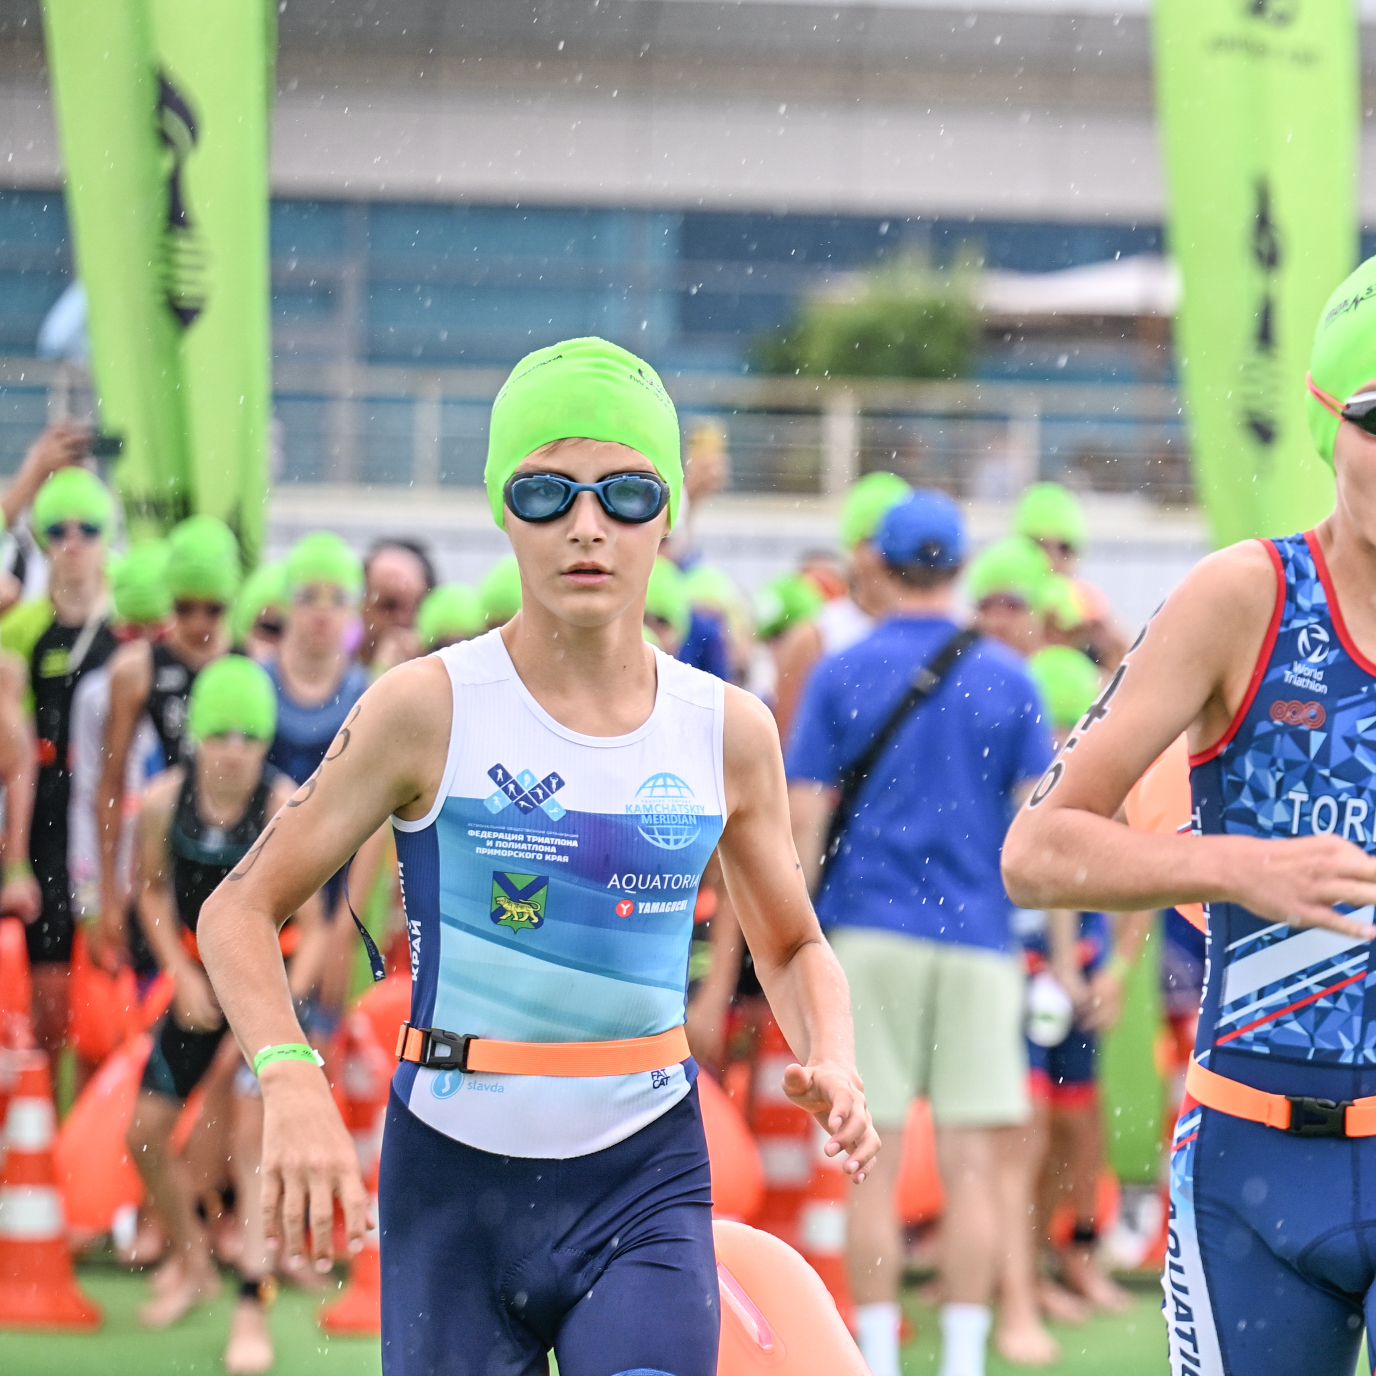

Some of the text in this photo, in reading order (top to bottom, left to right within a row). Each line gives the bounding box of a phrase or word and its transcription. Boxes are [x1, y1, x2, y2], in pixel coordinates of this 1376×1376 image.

[1293, 661, 1324, 681] World
[1283, 670, 1328, 695] Triathlon
[625, 804, 705, 814] KAMCHATSKIY
[641, 814, 697, 825] MERIDIAN
[468, 829, 578, 847] ФЕДЕРАЦИЯ ТРИАТЛОНА
[495, 840, 557, 853] ПОЛИАТЛОНА
[475, 847, 569, 863] ПРИМОРСКОГО КРАЯ
[607, 873, 700, 894] AQUATORIA
[638, 900, 689, 914] YAMAGUCHI
[408, 919, 422, 981] КРАЙ
[651, 1069, 668, 1081] FAT
[467, 1080, 505, 1094] slavda
[652, 1077, 670, 1090] CAT
